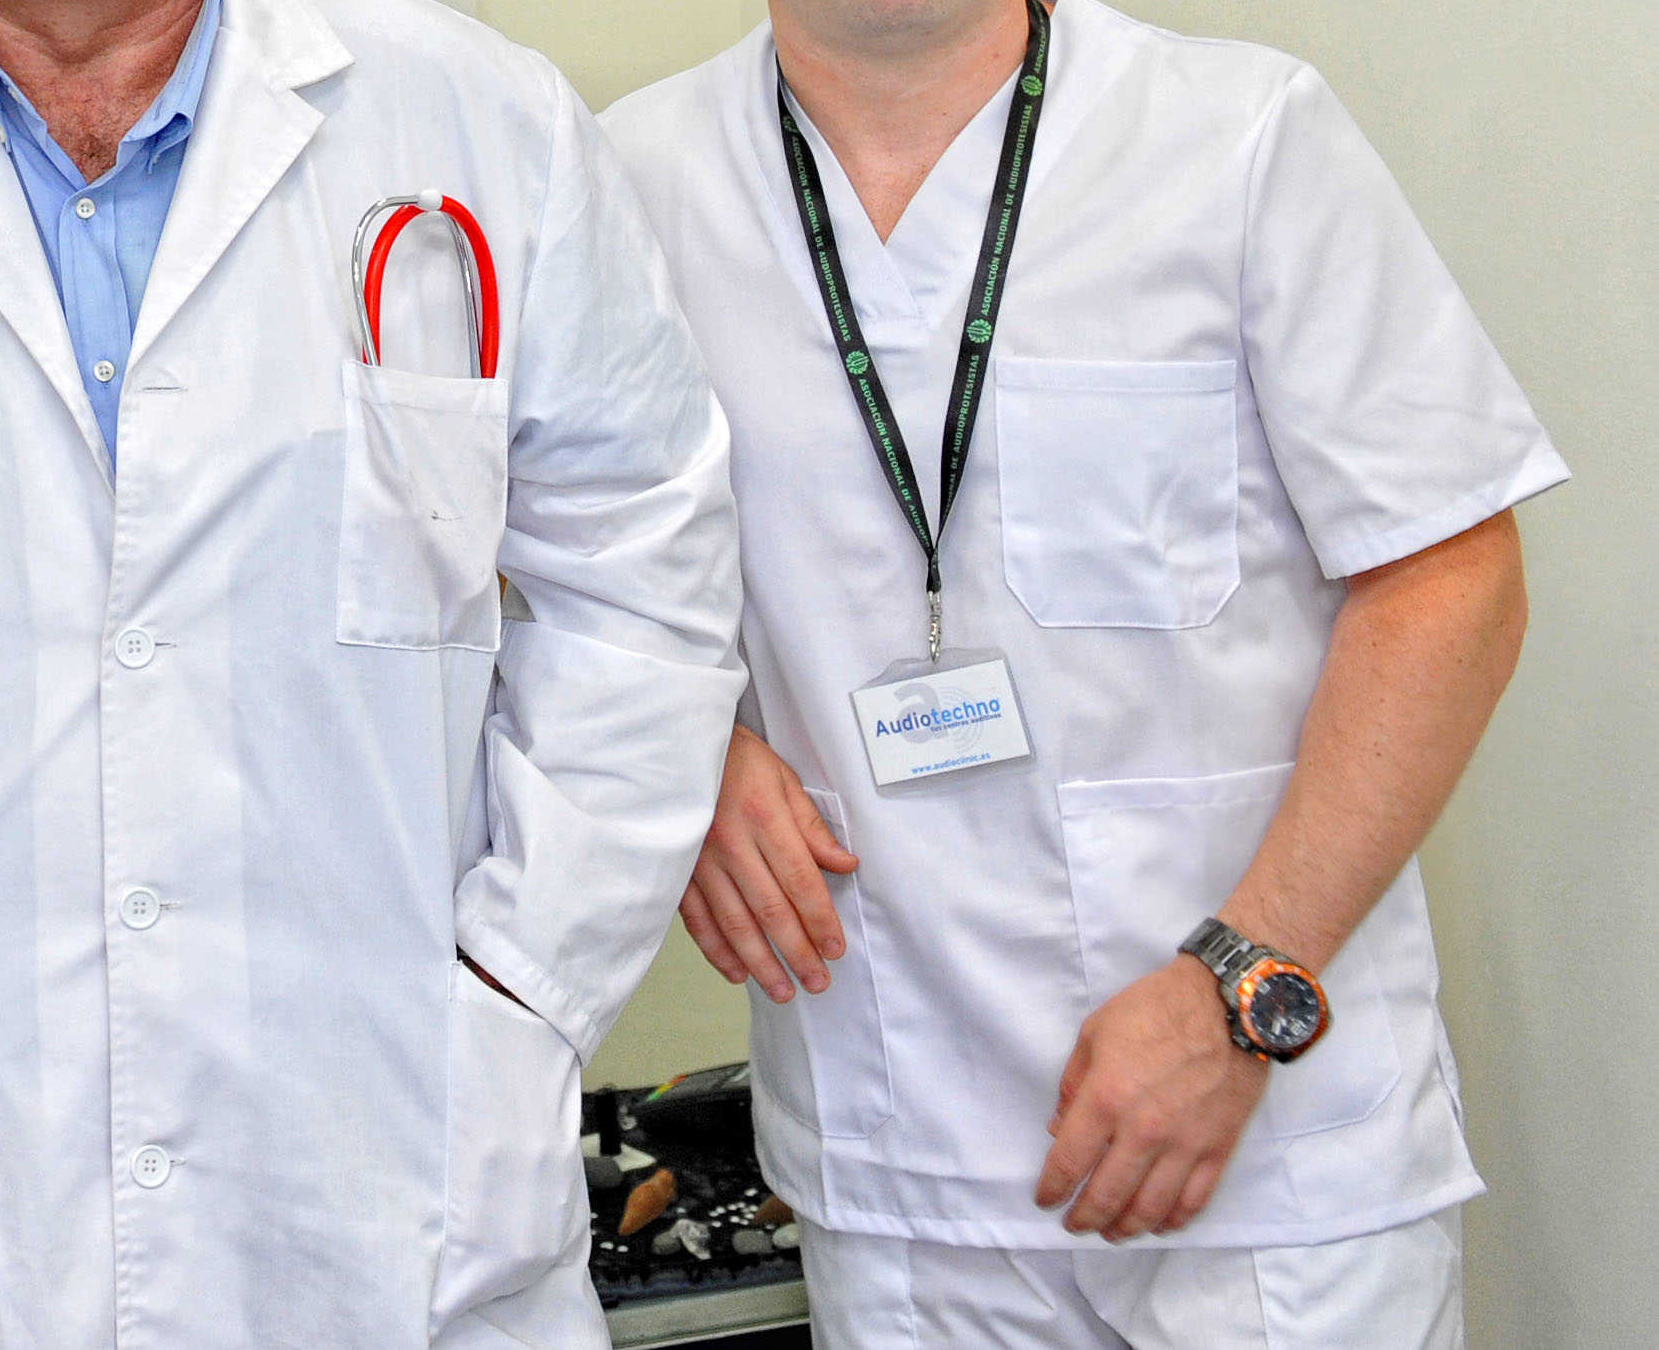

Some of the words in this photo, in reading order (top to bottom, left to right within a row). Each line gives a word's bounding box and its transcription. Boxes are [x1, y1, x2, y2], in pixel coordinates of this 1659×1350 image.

[994, 208, 1011, 255] NACIONAL
[1004, 193, 1015, 206] DE
[814, 236, 824, 248] DE
[819, 251, 852, 342] AUDIOPROTESISTAS
[858, 378, 887, 436] ASOCIACIÓN
[881, 437, 905, 486] NACIONAL
[901, 488, 912, 501] DE
[875, 697, 1001, 738] Audiotechno
